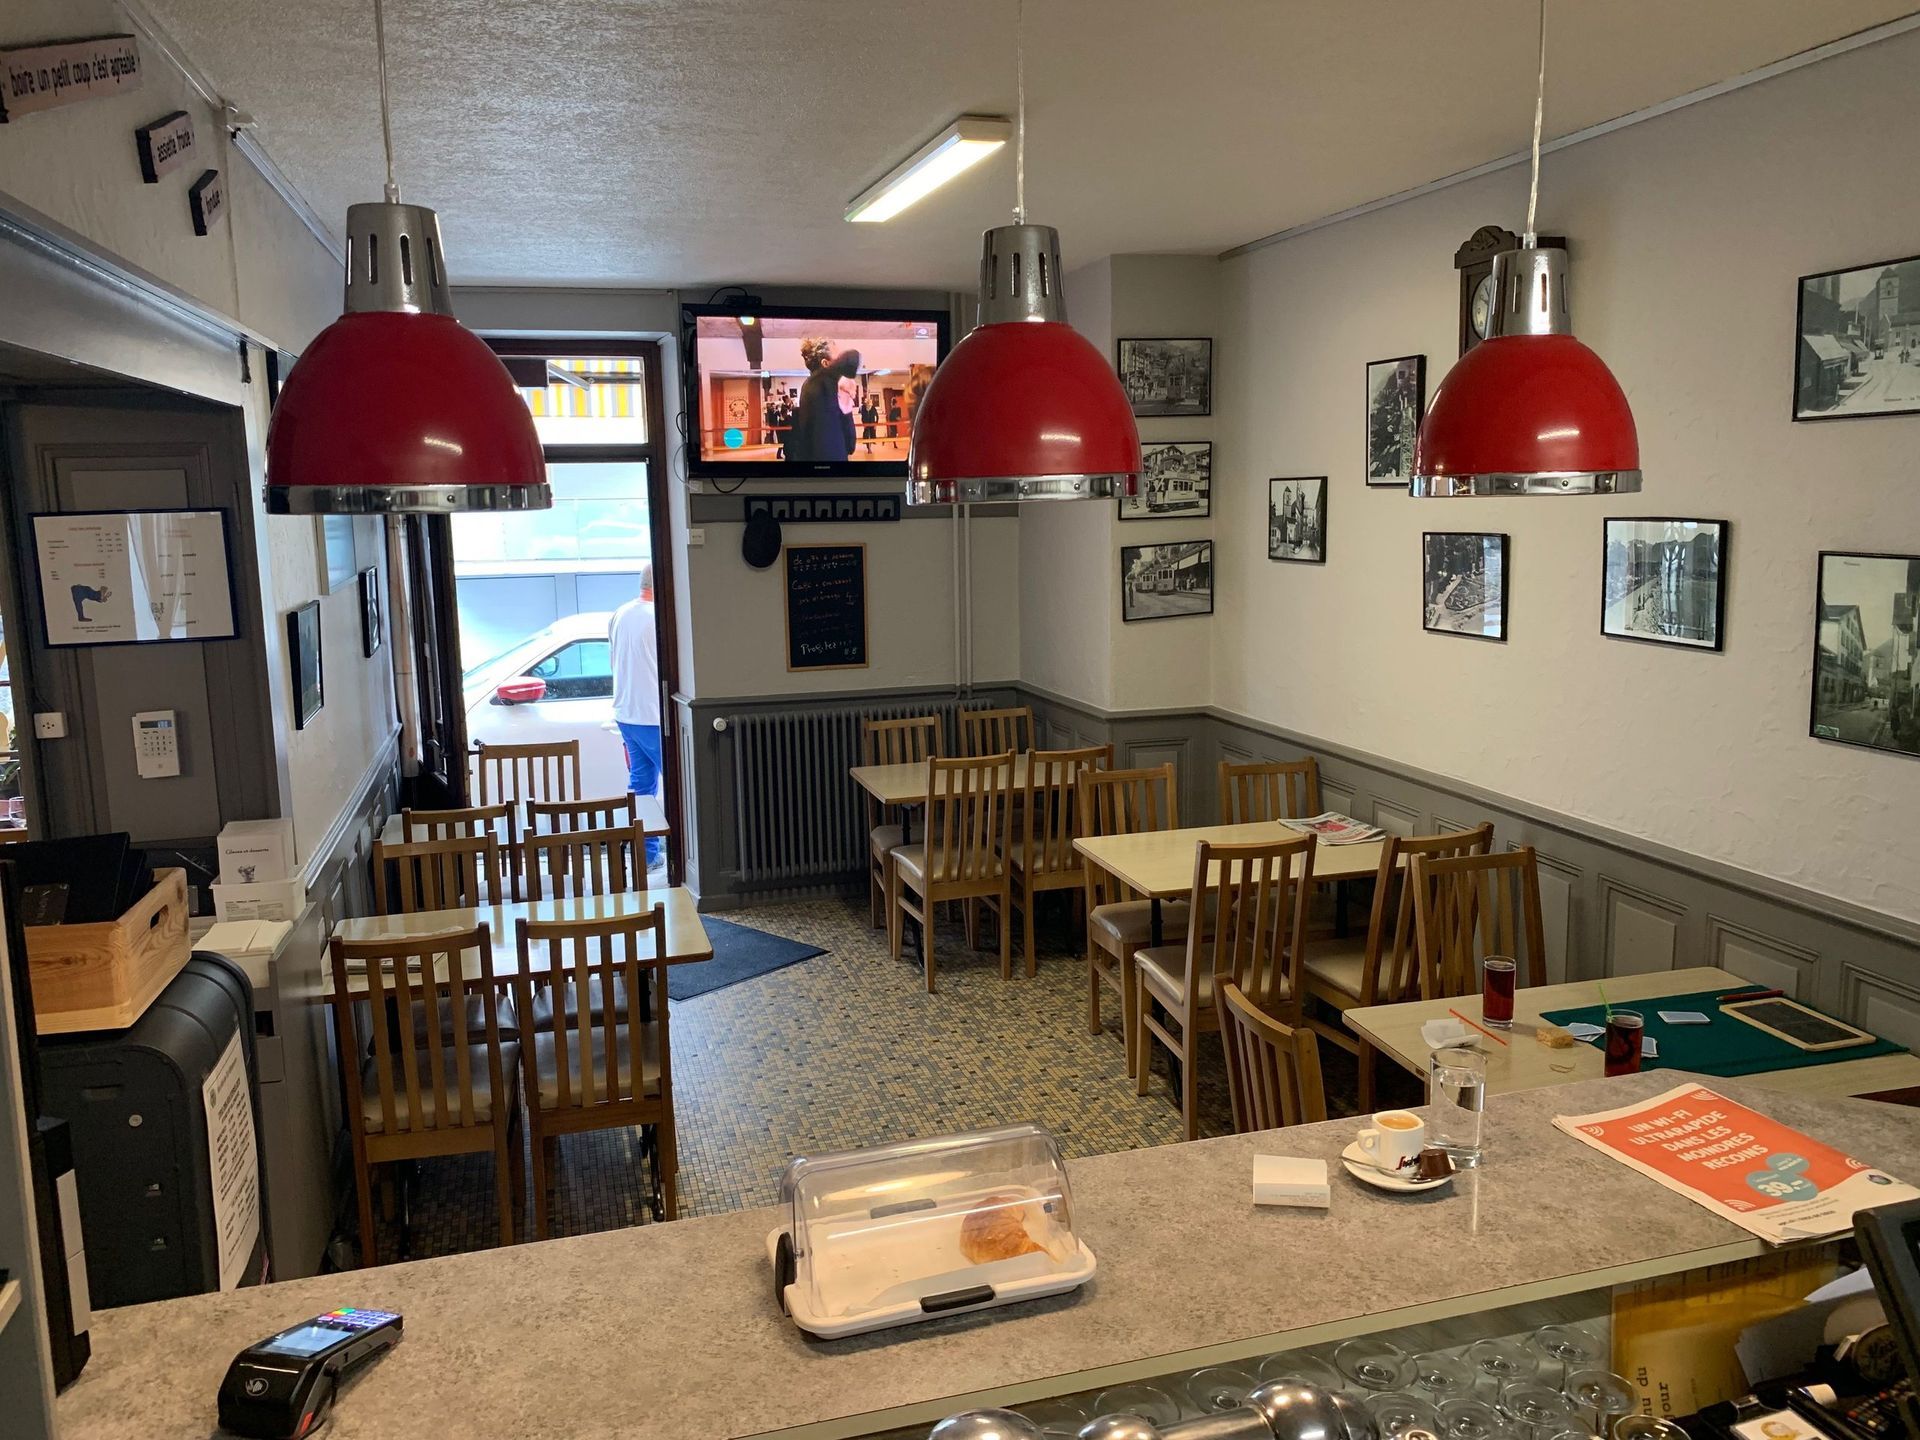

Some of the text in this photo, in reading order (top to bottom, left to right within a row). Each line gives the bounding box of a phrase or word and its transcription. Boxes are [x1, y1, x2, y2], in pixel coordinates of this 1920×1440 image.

[9, 47, 136, 97] boire un petit coup c'est agréable
[157, 134, 178, 163] assiette
[1628, 1109, 1693, 1133] UN WI-FI
[1628, 1110, 1728, 1146] ULTRARAPIDE
[1661, 1125, 1732, 1152] DANS LES
[1676, 1132, 1756, 1163] MOINDRES
[1701, 1144, 1769, 1170] RECOINS
[1636, 1367, 1649, 1387] du
[1658, 1382, 1676, 1420] jour
